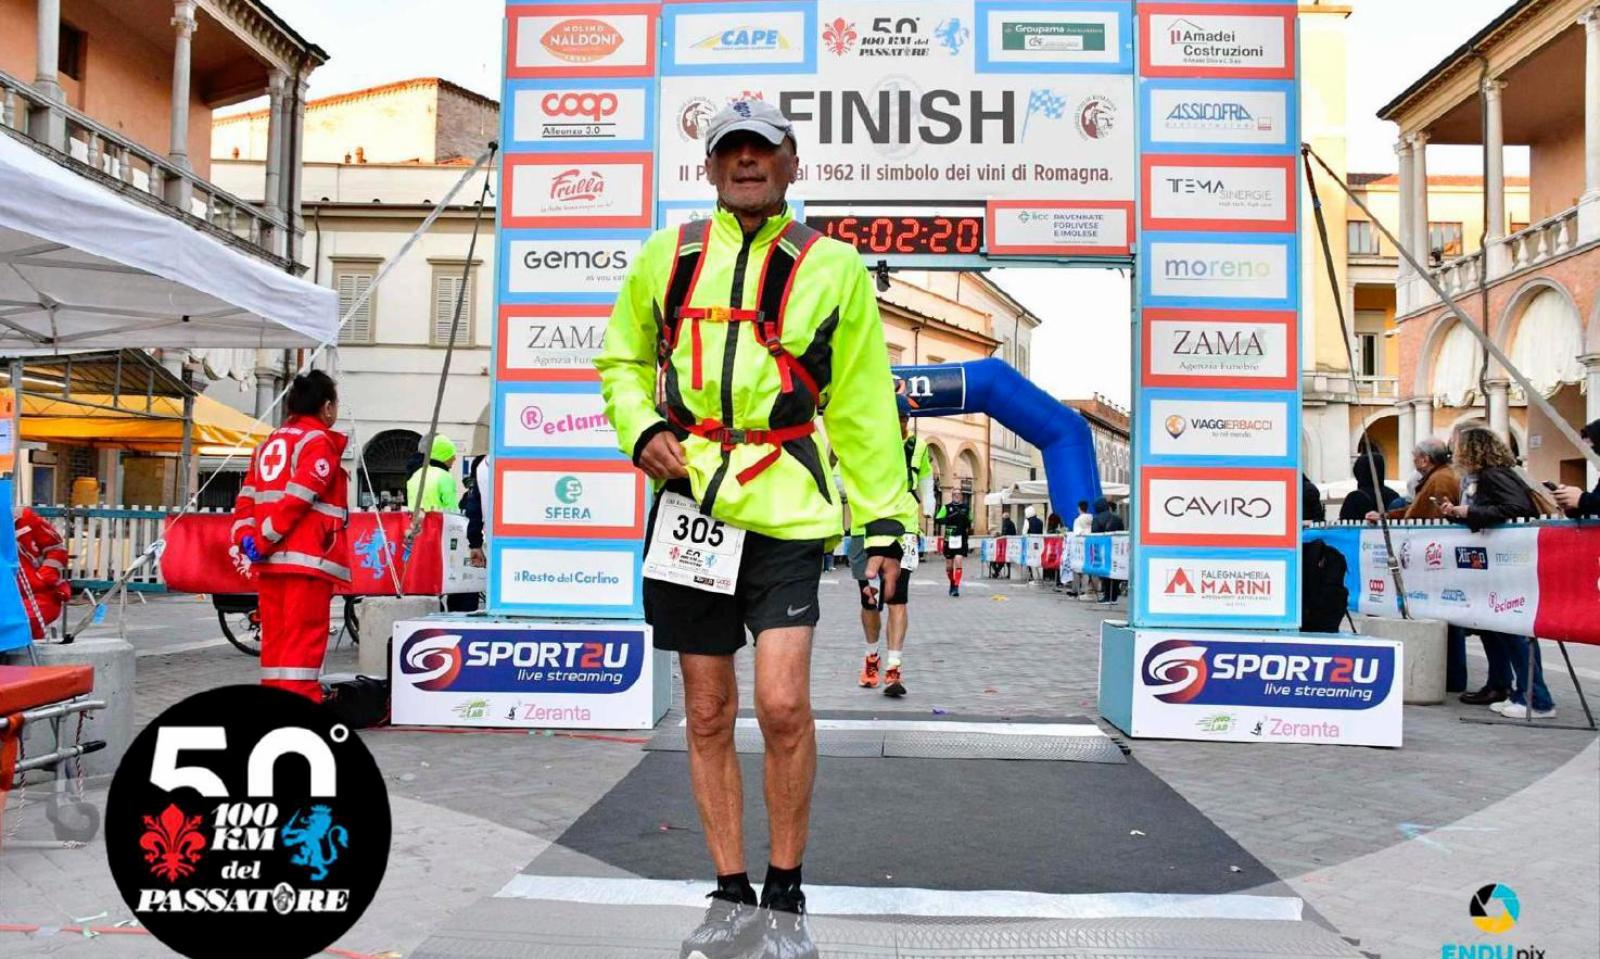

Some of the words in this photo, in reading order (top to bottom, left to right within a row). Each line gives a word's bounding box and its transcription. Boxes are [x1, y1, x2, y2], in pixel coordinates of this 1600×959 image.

[563, 25, 605, 33] MOLINO
[1015, 25, 1064, 34] Groupama
[1183, 30, 1235, 42] Amadei
[550, 33, 616, 46] NALDONI
[721, 30, 778, 46] CAPE
[862, 37, 885, 45] 100
[888, 37, 911, 45] KM
[859, 48, 929, 56] PASSATORE
[1184, 45, 1263, 57] Costruzioni
[541, 93, 618, 121] coop
[1166, 103, 1253, 121] ASSICOFRA
[780, 89, 1015, 144] FINISH
[542, 127, 582, 135] Alleanza
[586, 126, 600, 135] 3.0
[795, 164, 808, 181] al
[817, 164, 854, 181] 1962
[861, 163, 869, 181] il
[876, 163, 939, 181] simbolo
[946, 163, 970, 181] dei
[977, 163, 1005, 181] vini
[1012, 163, 1026, 181] di
[1035, 163, 1113, 184] Romagna.
[1166, 178, 1224, 193] TEMA
[1219, 190, 1271, 201] SINERGIE
[827, 218, 979, 252] 15:02:20
[1166, 259, 1270, 277] moreno
[1173, 329, 1264, 355] ZAMA
[1179, 361, 1217, 372] Agenzia
[1220, 362, 1259, 371] Funebre
[521, 405, 608, 435] Reclam
[1191, 418, 1272, 430] VIAGGIERBACCI
[545, 507, 591, 519] SFERA
[1164, 496, 1271, 518] CAVIRO
[672, 514, 725, 547] 305
[514, 571, 520, 582] il
[522, 570, 555, 582] Resto
[557, 573, 573, 583] del
[575, 571, 620, 584] Carlino
[1201, 570, 1271, 579] FALEGNAMERIA
[1201, 580, 1271, 594] MARINI
[465, 641, 629, 668] SPORT2U
[1211, 653, 1379, 684] SPORT2U
[517, 669, 542, 681] live
[546, 670, 623, 685] streaming
[1264, 683, 1290, 696] live
[1296, 685, 1372, 701] streaming
[524, 703, 591, 721] Zeranta
[1269, 717, 1340, 738] Zeranta
